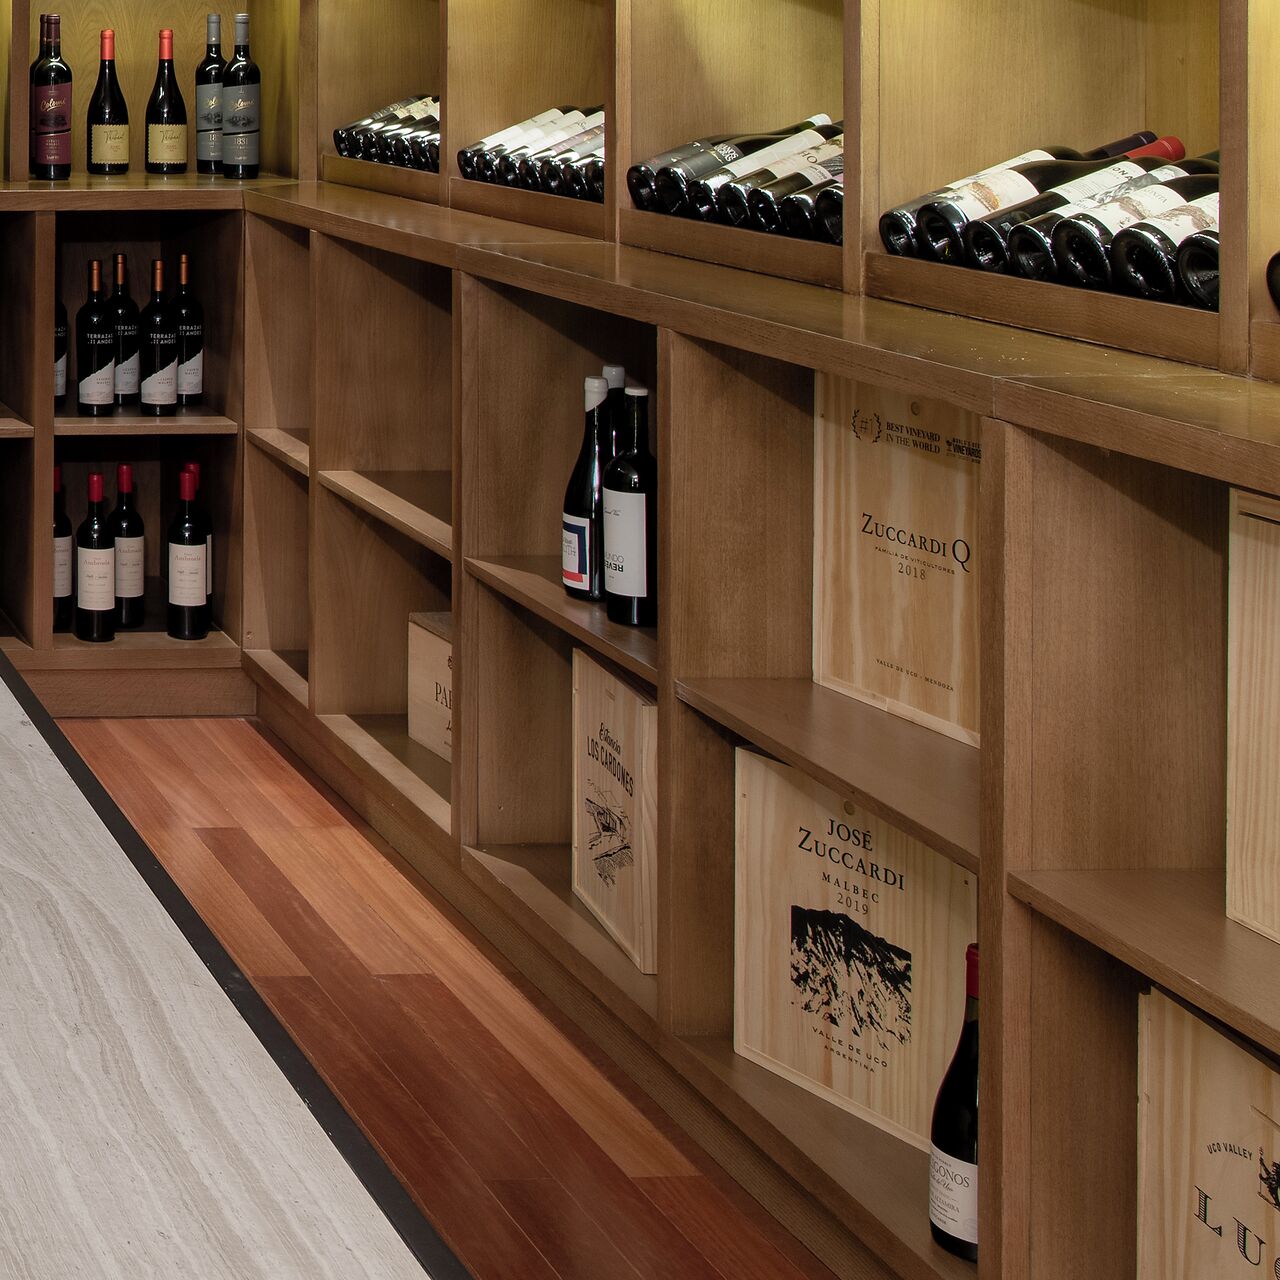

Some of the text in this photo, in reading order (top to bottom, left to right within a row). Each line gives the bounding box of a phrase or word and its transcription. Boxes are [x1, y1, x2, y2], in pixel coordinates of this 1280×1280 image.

[886, 421, 940, 442] BEST VINEYARD
[886, 433, 940, 454] IN THE WORLD
[861, 512, 970, 573] ZUCCARDI Q
[604, 560, 624, 573] REVE
[898, 561, 927, 580] 2018
[587, 735, 634, 798] LOS CARDONES
[827, 818, 873, 852] JOSÉ
[798, 826, 905, 891] ZUCCARDI
[822, 871, 880, 904] MALBEC
[837, 892, 870, 916] 2019
[812, 1026, 888, 1068] VALLE DE UCO
[824, 1045, 875, 1073] ARGENTINA
[1206, 1142, 1253, 1161] UCO VALLEY
